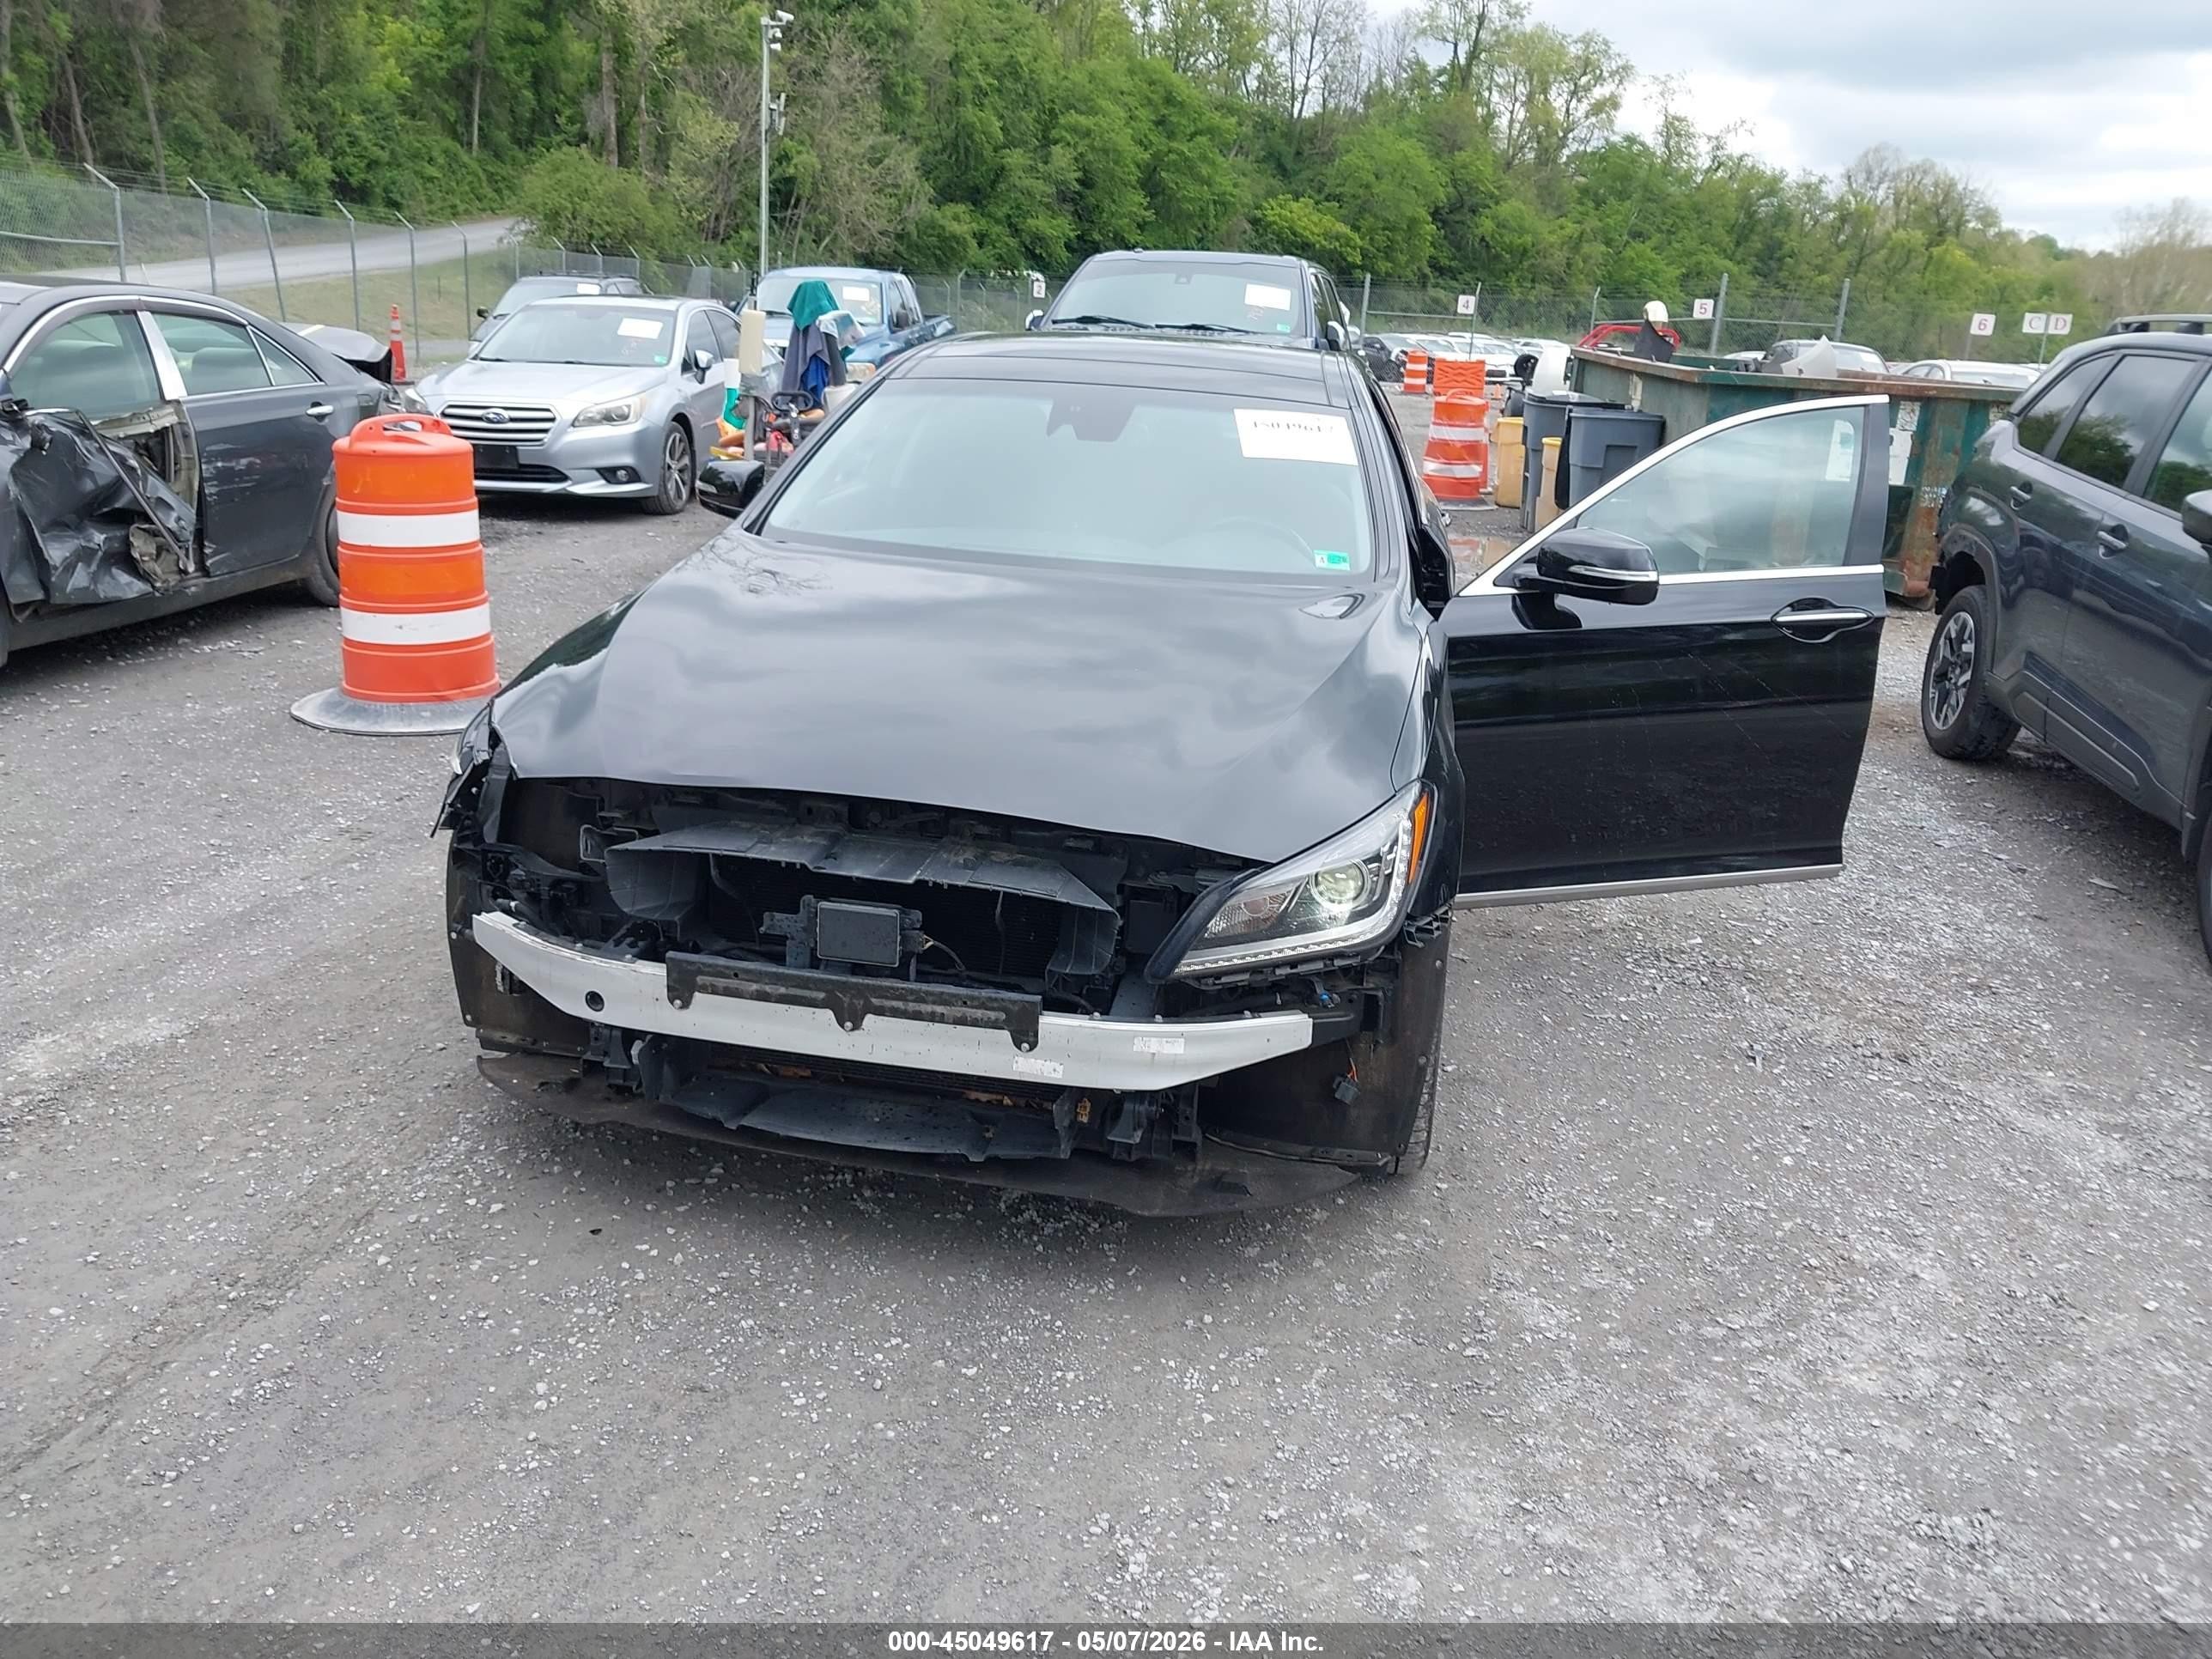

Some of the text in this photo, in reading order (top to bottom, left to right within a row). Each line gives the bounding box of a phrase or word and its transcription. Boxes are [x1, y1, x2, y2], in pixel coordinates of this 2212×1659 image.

[1462, 299, 1470, 310] 4
[1698, 302, 1708, 315] 5
[1978, 318, 1988, 331] 6
[2028, 316, 2041, 330] C
[2054, 317, 2067, 331] D
